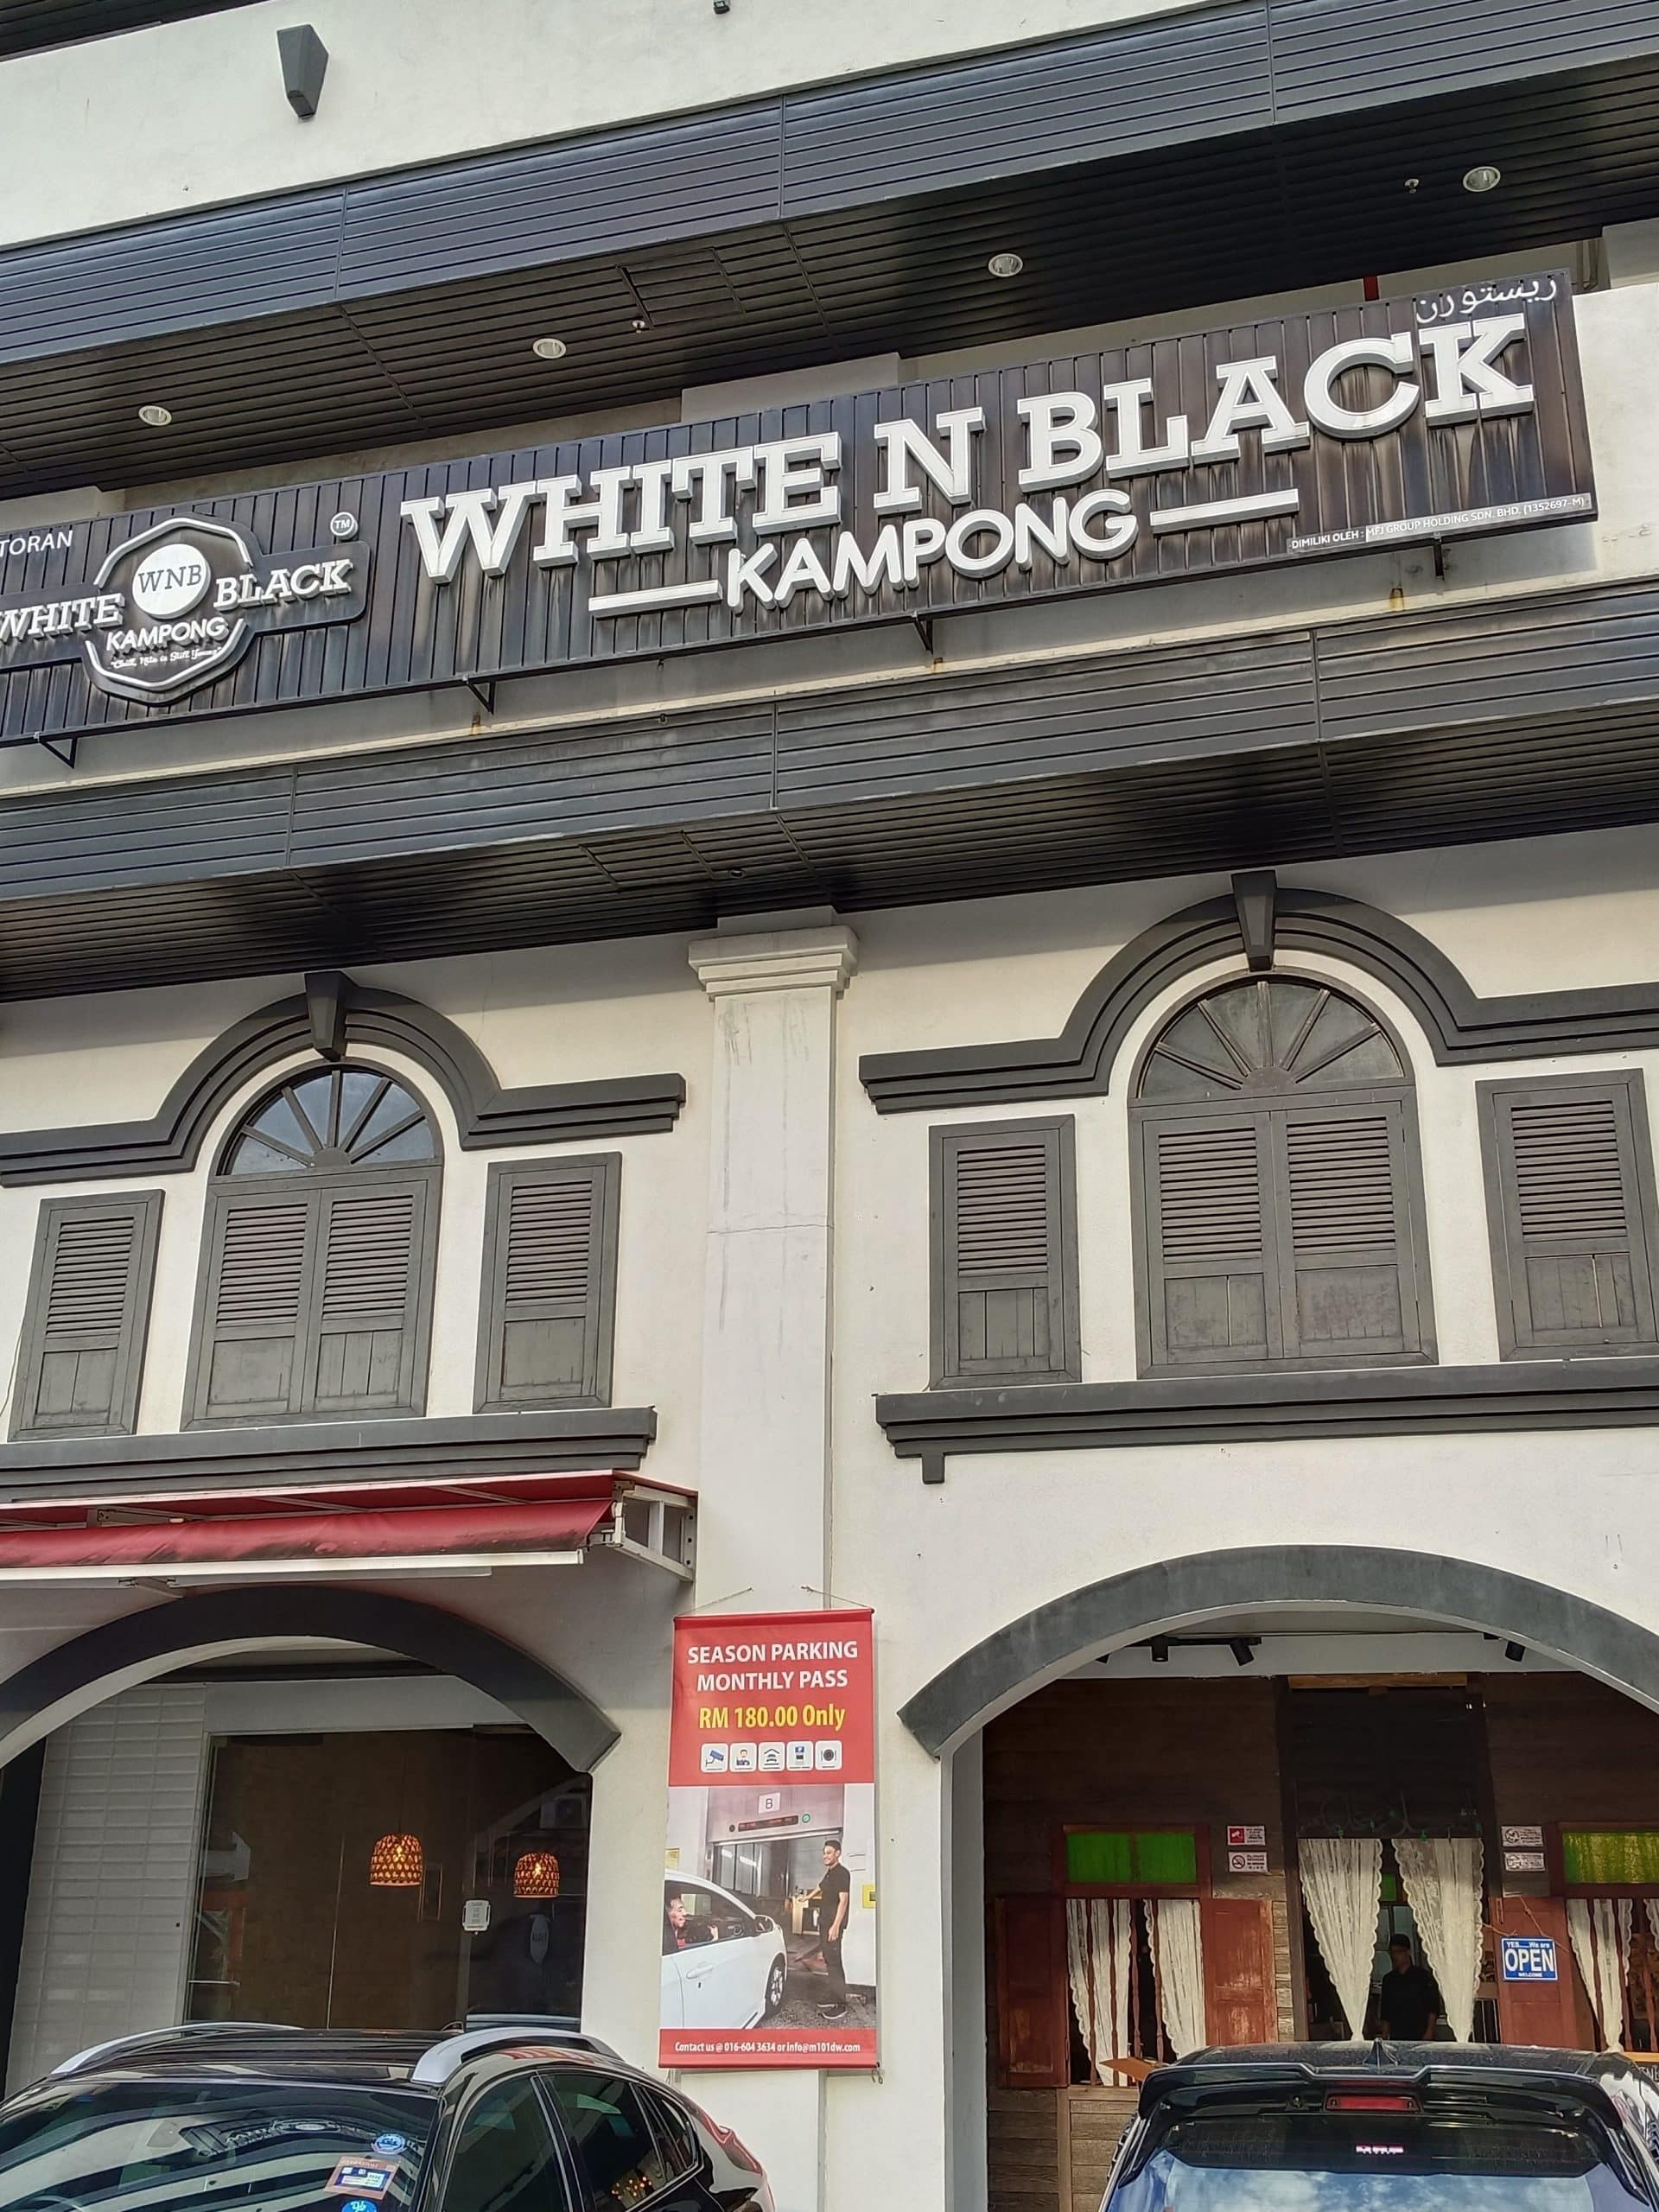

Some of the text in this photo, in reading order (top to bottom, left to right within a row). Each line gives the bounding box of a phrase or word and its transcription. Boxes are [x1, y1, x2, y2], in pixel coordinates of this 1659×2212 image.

[400, 312, 1535, 585] WHITE N BLACK
[334, 519, 350, 529] TM
[1291, 531, 1332, 550] DIMILIKI
[1332, 529, 1360, 543] OLEH
[1367, 523, 1385, 537] MFJ
[1386, 519, 1421, 535] GROUP
[1422, 512, 1470, 531] HOLDING
[1497, 505, 1522, 519] BHD.
[1523, 497, 1585, 517] (1352697-M)
[727, 488, 1139, 614] KAMPONG
[138, 564, 202, 594] WNB
[0, 559, 354, 642] WHITE BLACK
[106, 617, 229, 652] KAMPONG
[688, 1641, 858, 1664] SEASON PARKING
[697, 1669, 849, 1692] MONTHLY PASS
[699, 1703, 845, 1732] RM 180.00 Only
[766, 1798, 773, 1809] B
[1505, 1948, 1554, 1972] OPEN
[675, 2042, 861, 2053] Contact us @ 016-604 3634 or info@m101dw.com
